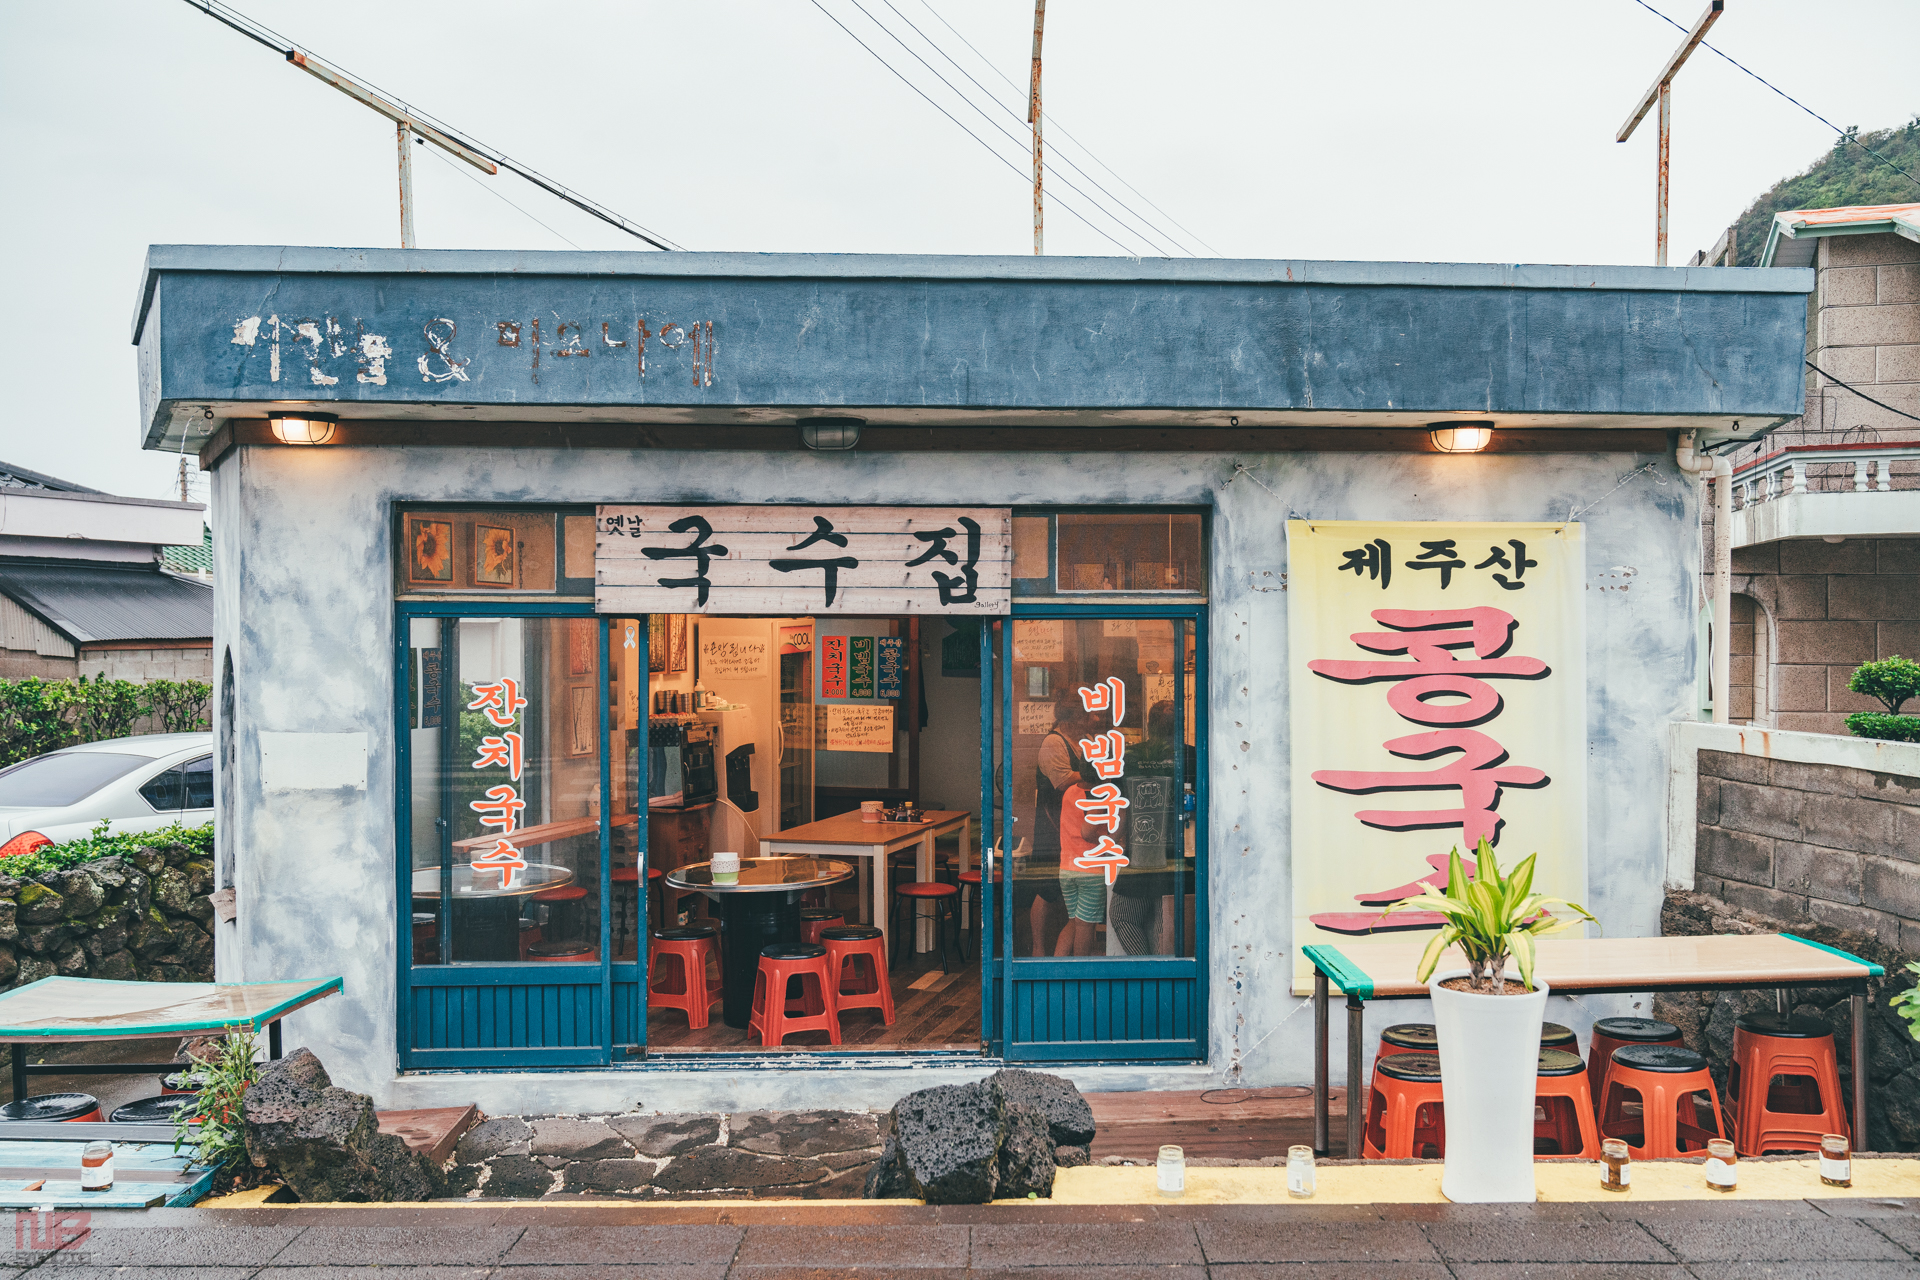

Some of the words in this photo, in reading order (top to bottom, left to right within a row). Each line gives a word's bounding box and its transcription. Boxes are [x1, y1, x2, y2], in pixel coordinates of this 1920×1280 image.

[606, 514, 643, 538] 옛날
[640, 514, 982, 608] 국수집
[1338, 538, 1538, 591] 제주산
[973, 601, 999, 610] gallery
[793, 632, 811, 646] COOL
[825, 639, 844, 687] 잔치국수
[851, 639, 873, 688] 비빔국수
[880, 648, 901, 688] 콩국수
[424, 662, 441, 714] 콩국수
[852, 688, 873, 697] 4,000
[468, 677, 528, 890] 잔치국수
[1074, 676, 1129, 886] 비빔국수
